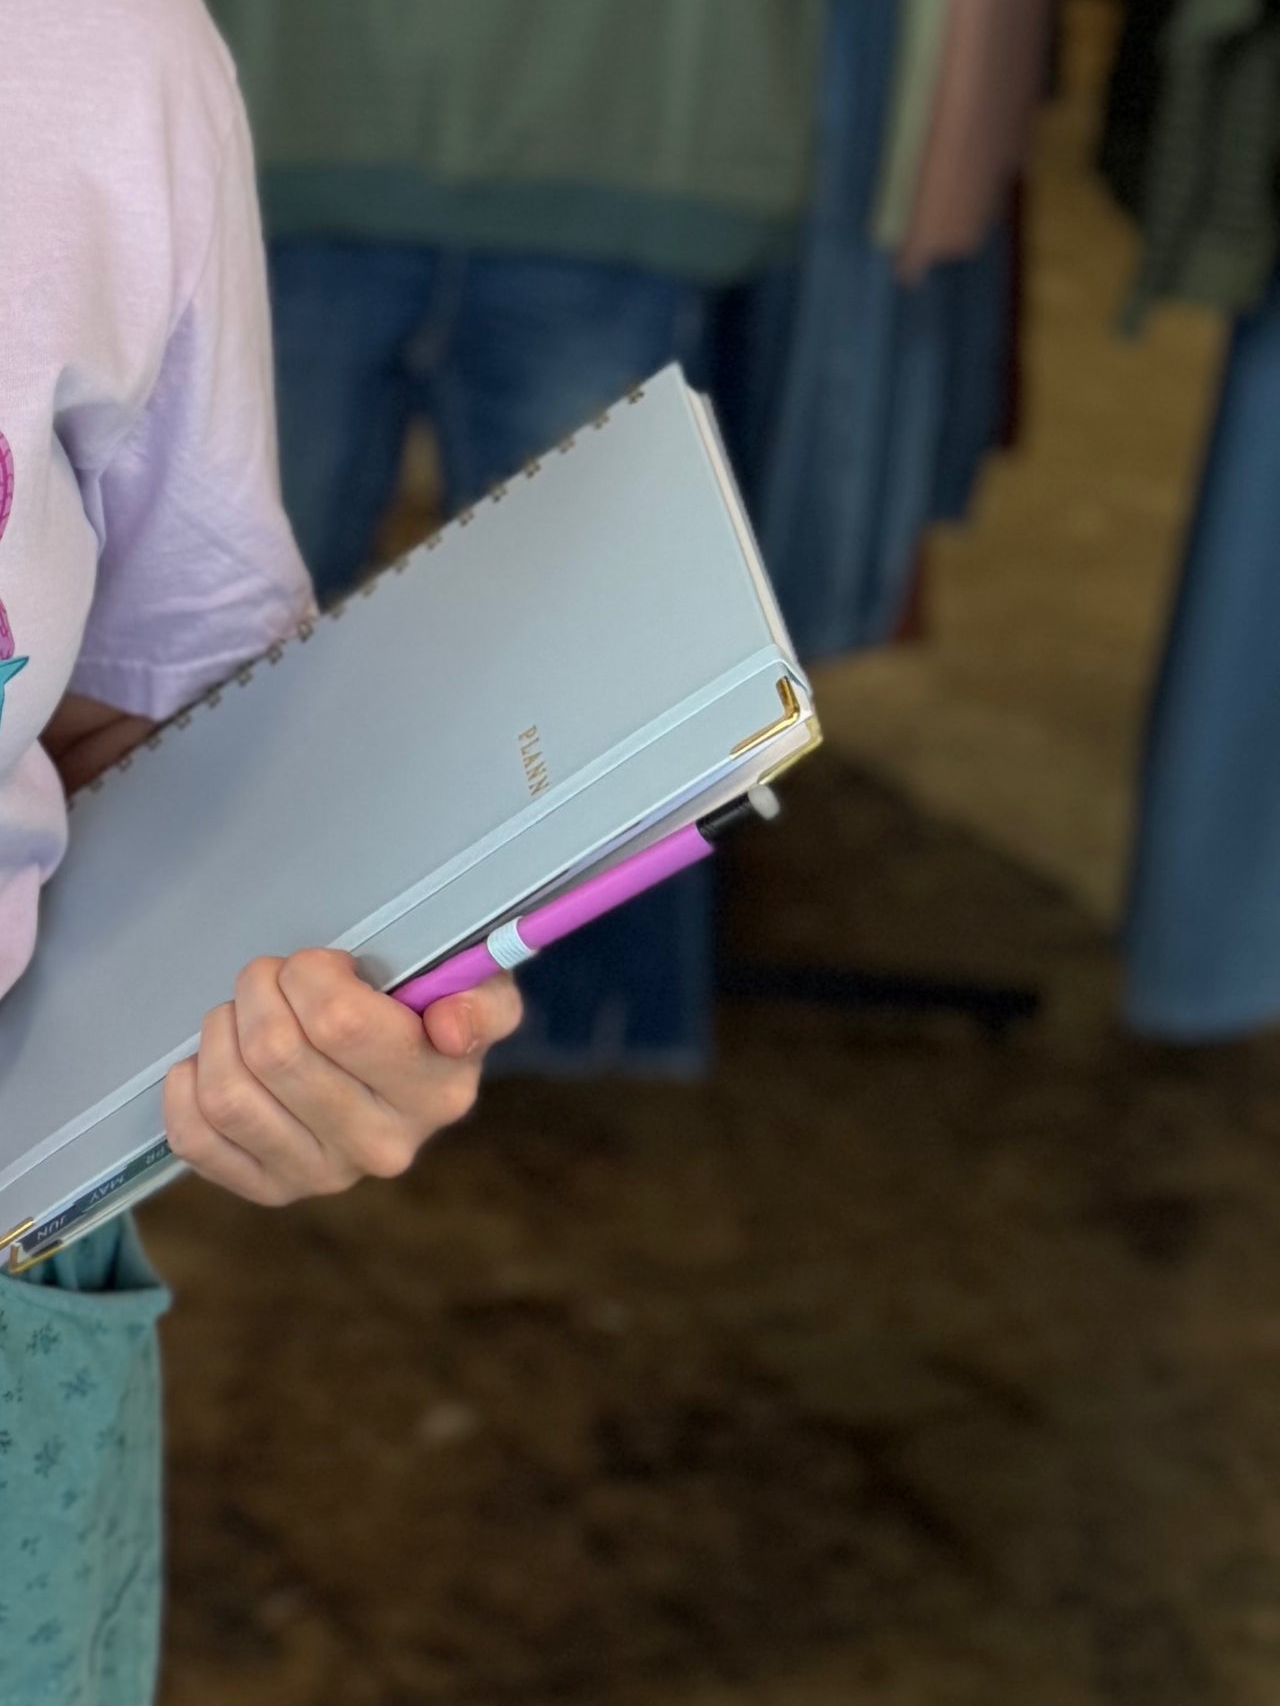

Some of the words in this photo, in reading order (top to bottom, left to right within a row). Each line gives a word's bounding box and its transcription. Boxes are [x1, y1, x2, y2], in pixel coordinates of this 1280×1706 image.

[518, 724, 550, 797] PLANN
[144, 1144, 166, 1165] PR
[90, 1173, 126, 1202] MAY
[36, 1214, 66, 1241] JUN
